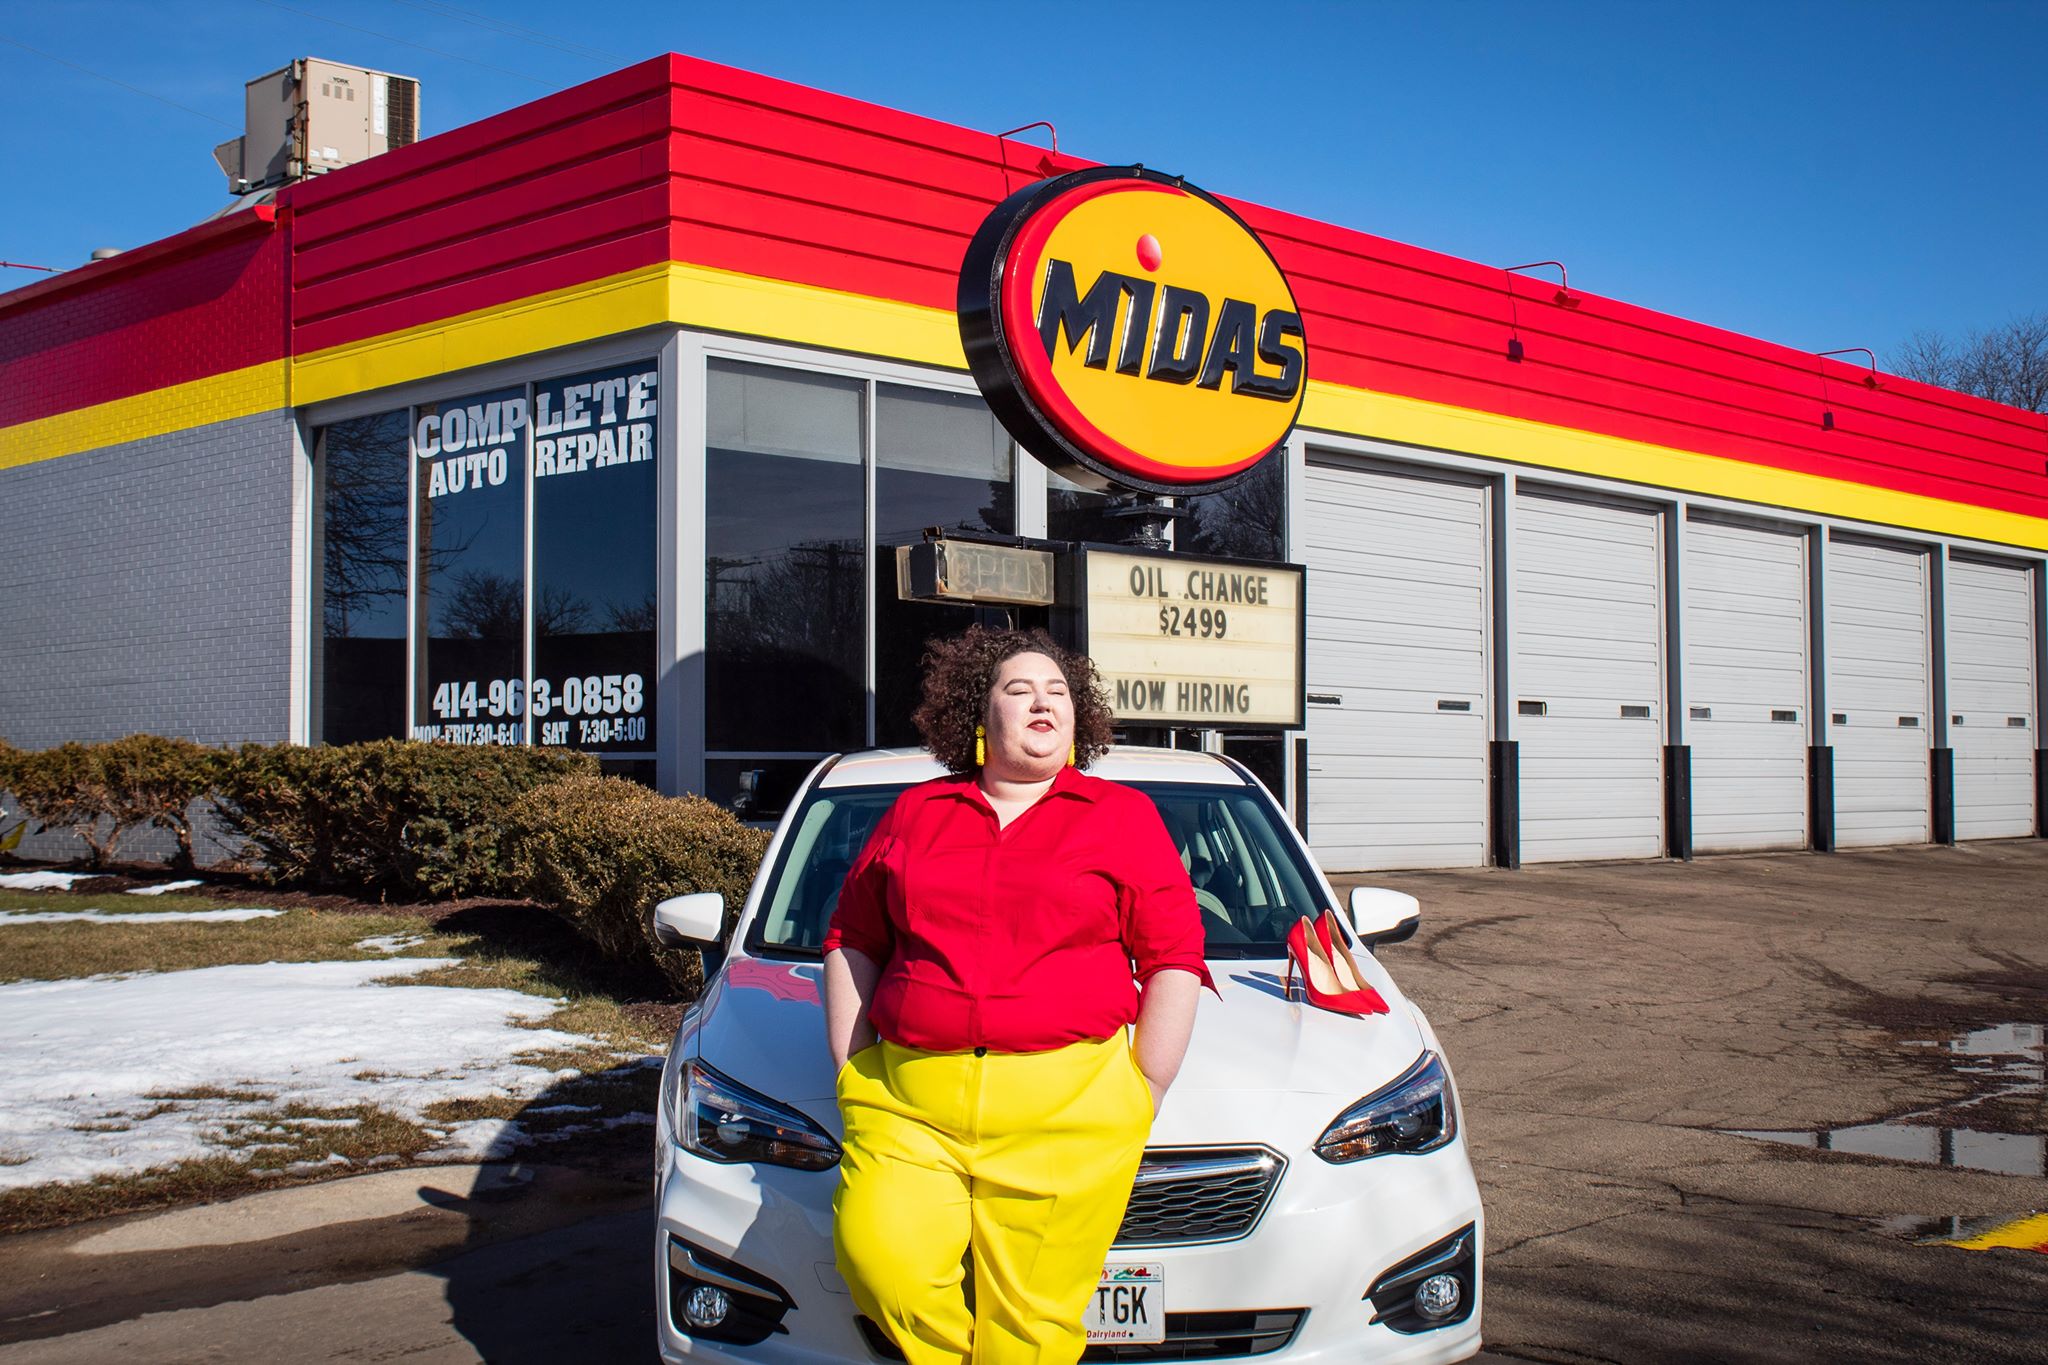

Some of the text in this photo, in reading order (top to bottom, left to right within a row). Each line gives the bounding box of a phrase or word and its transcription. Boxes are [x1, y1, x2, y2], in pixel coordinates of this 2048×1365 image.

[1034, 236, 1304, 403] MIDAS
[417, 371, 658, 458] COMPLETE
[428, 423, 653, 498] AUTO REPAIR
[1129, 565, 1169, 598] OIL
[1159, 605, 1227, 639] $2499
[432, 673, 644, 719] 414-963-0858
[1116, 679, 1251, 714] NOW HIRING
[542, 720, 570, 745] SAT
[579, 716, 646, 743] 7:30-5:00
[1086, 1330, 1127, 1340] Dairyland
